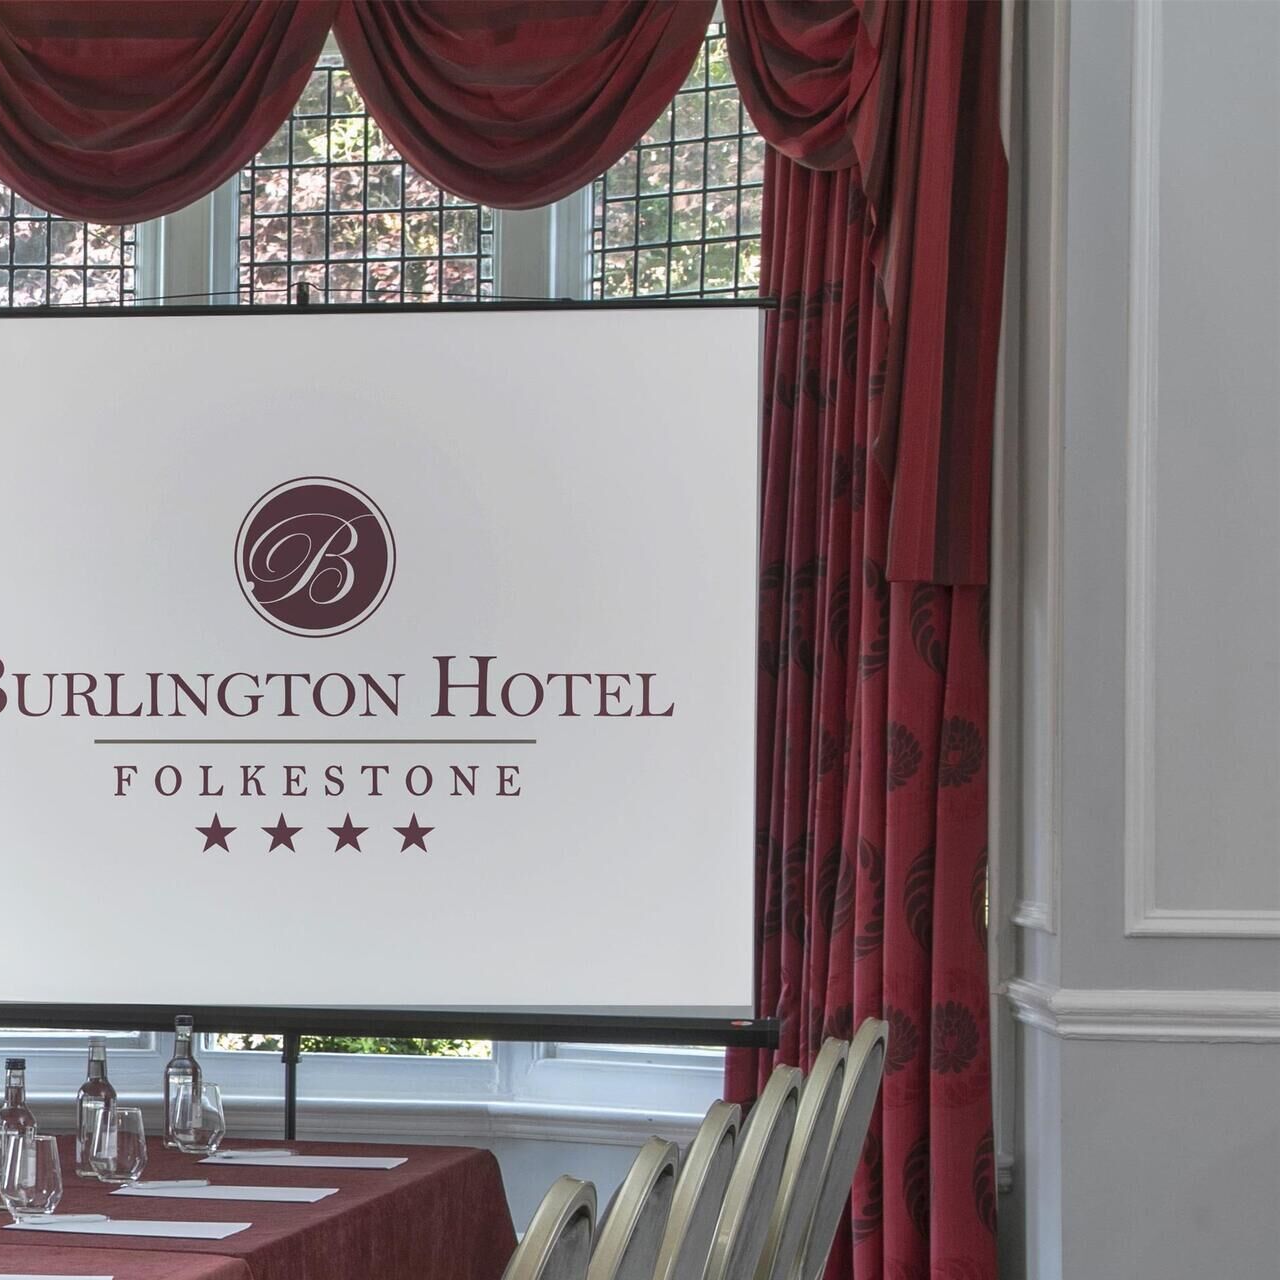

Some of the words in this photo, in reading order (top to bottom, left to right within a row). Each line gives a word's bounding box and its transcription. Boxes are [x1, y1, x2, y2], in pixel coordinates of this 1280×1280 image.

[246, 512, 376, 605] B
[430, 654, 675, 718] HOTEL
[113, 764, 523, 797] FOLKESTONE
